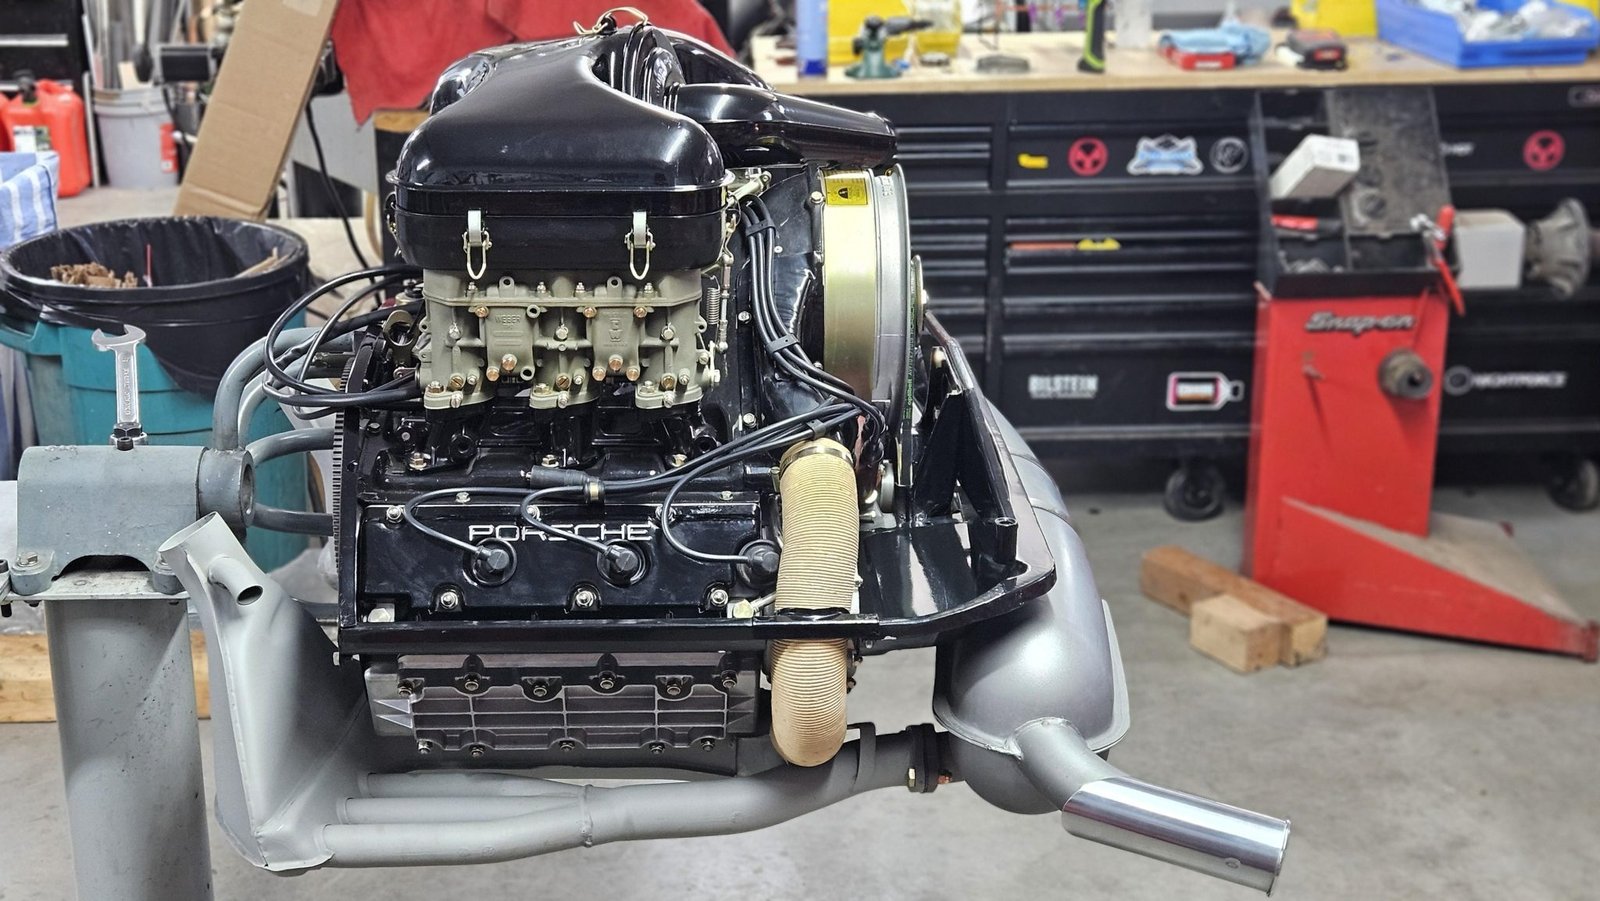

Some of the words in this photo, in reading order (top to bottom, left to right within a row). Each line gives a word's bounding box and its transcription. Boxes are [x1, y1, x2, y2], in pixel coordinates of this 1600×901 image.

[494, 314, 521, 324] WEBER
[1306, 313, 1414, 335] Snap-on
[1028, 375, 1099, 392] BILSTEIN
[468, 524, 654, 541] PORSCHE
